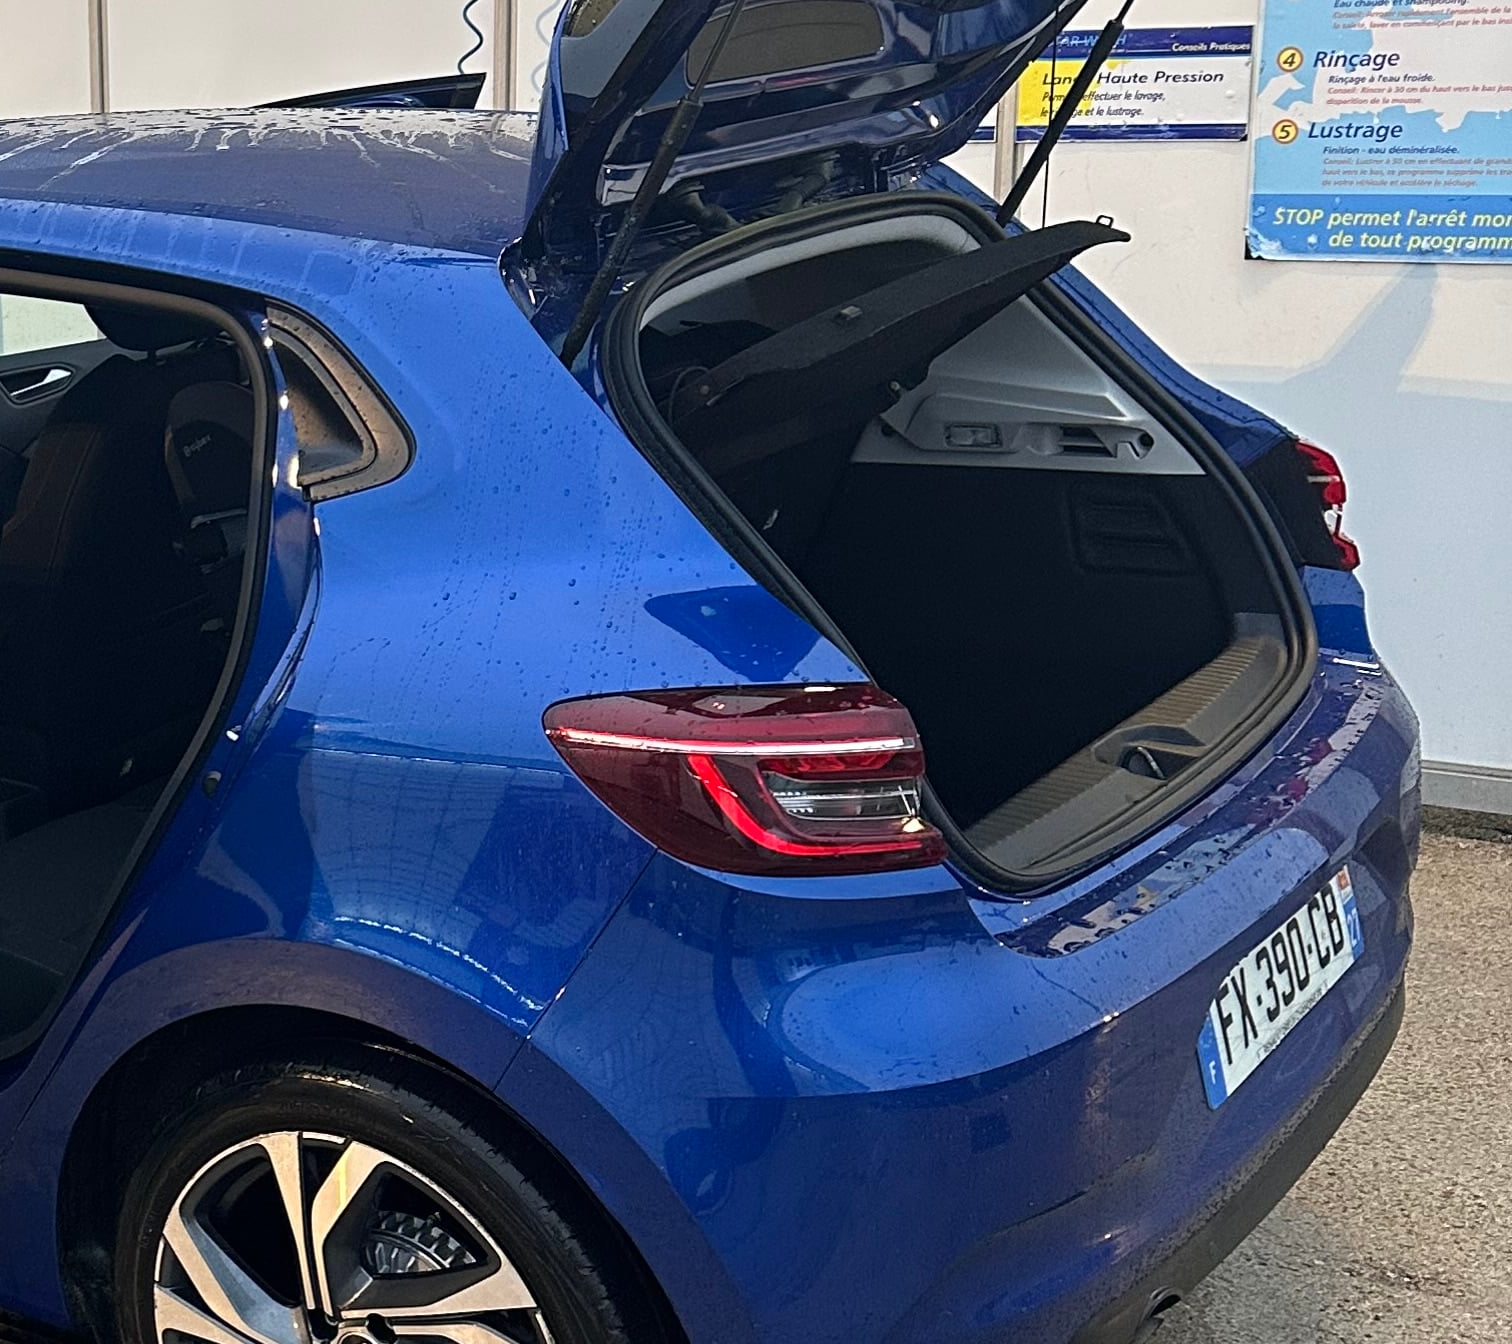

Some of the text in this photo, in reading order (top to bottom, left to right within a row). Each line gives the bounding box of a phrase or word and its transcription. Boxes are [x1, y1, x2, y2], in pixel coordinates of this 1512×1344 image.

[1334, 0, 1353, 8] Eau
[1283, 50, 1400, 72] 4 Rinçage
[1097, 71, 1148, 84] Haute
[1155, 69, 1224, 83] Pression
[1328, 73, 1436, 85] Rinçage à l'eau froide.
[1123, 89, 1133, 101] le
[1134, 89, 1166, 102] lavage,
[1085, 108, 1095, 116] et
[1096, 105, 1105, 117] le
[1278, 122, 1403, 143] 5 Lustrage
[1323, 145, 1360, 154] Finition
[1368, 146, 1386, 154] eau
[1388, 144, 1460, 154] déminéralisée.
[1273, 206, 1324, 225] STOP
[1327, 210, 1402, 229] permet
[1406, 208, 1468, 227] l'arrêt
[1329, 230, 1354, 247] de
[1360, 232, 1403, 248] tout
[1347, 907, 1361, 948] 27
[1208, 1060, 1216, 1085] F
